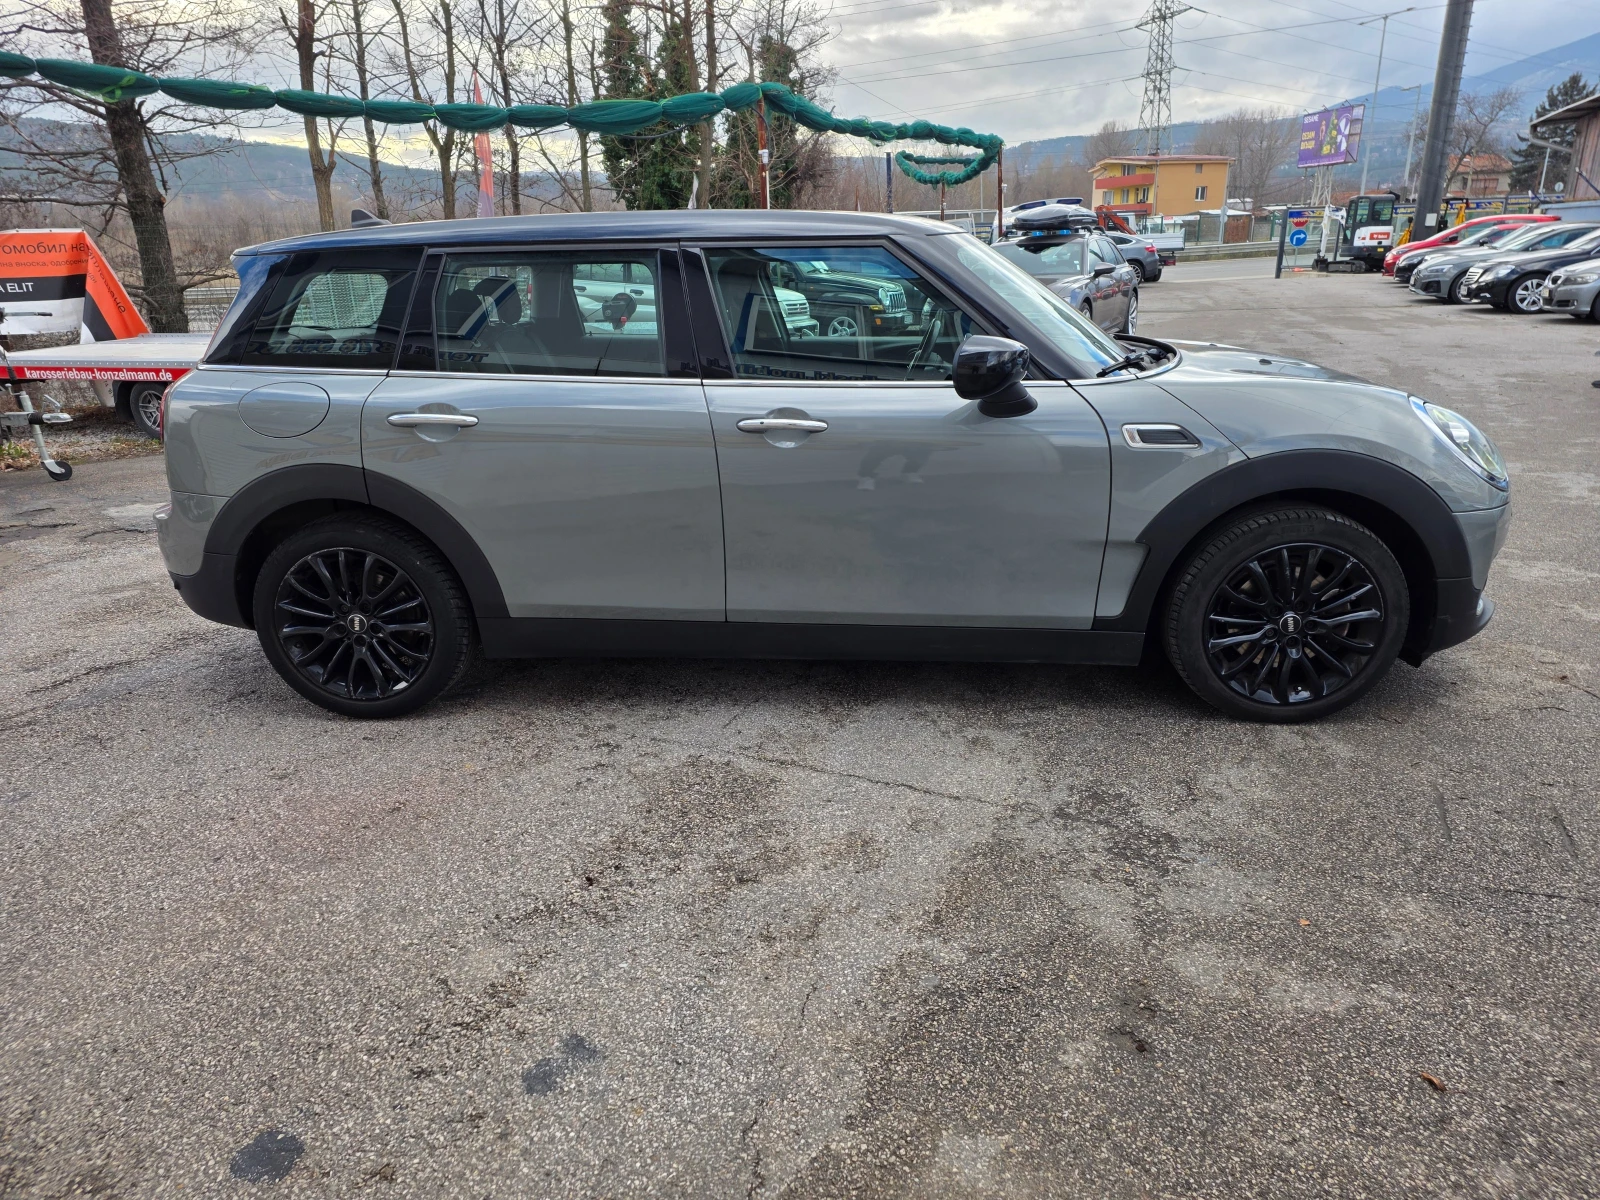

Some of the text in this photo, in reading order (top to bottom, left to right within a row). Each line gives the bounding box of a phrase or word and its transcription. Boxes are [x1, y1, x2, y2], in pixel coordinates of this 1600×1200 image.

[0, 242, 68, 254] омобил
[6, 282, 34, 293] ELIT
[24, 366, 173, 381] karosseriebau-konzelmann.de
